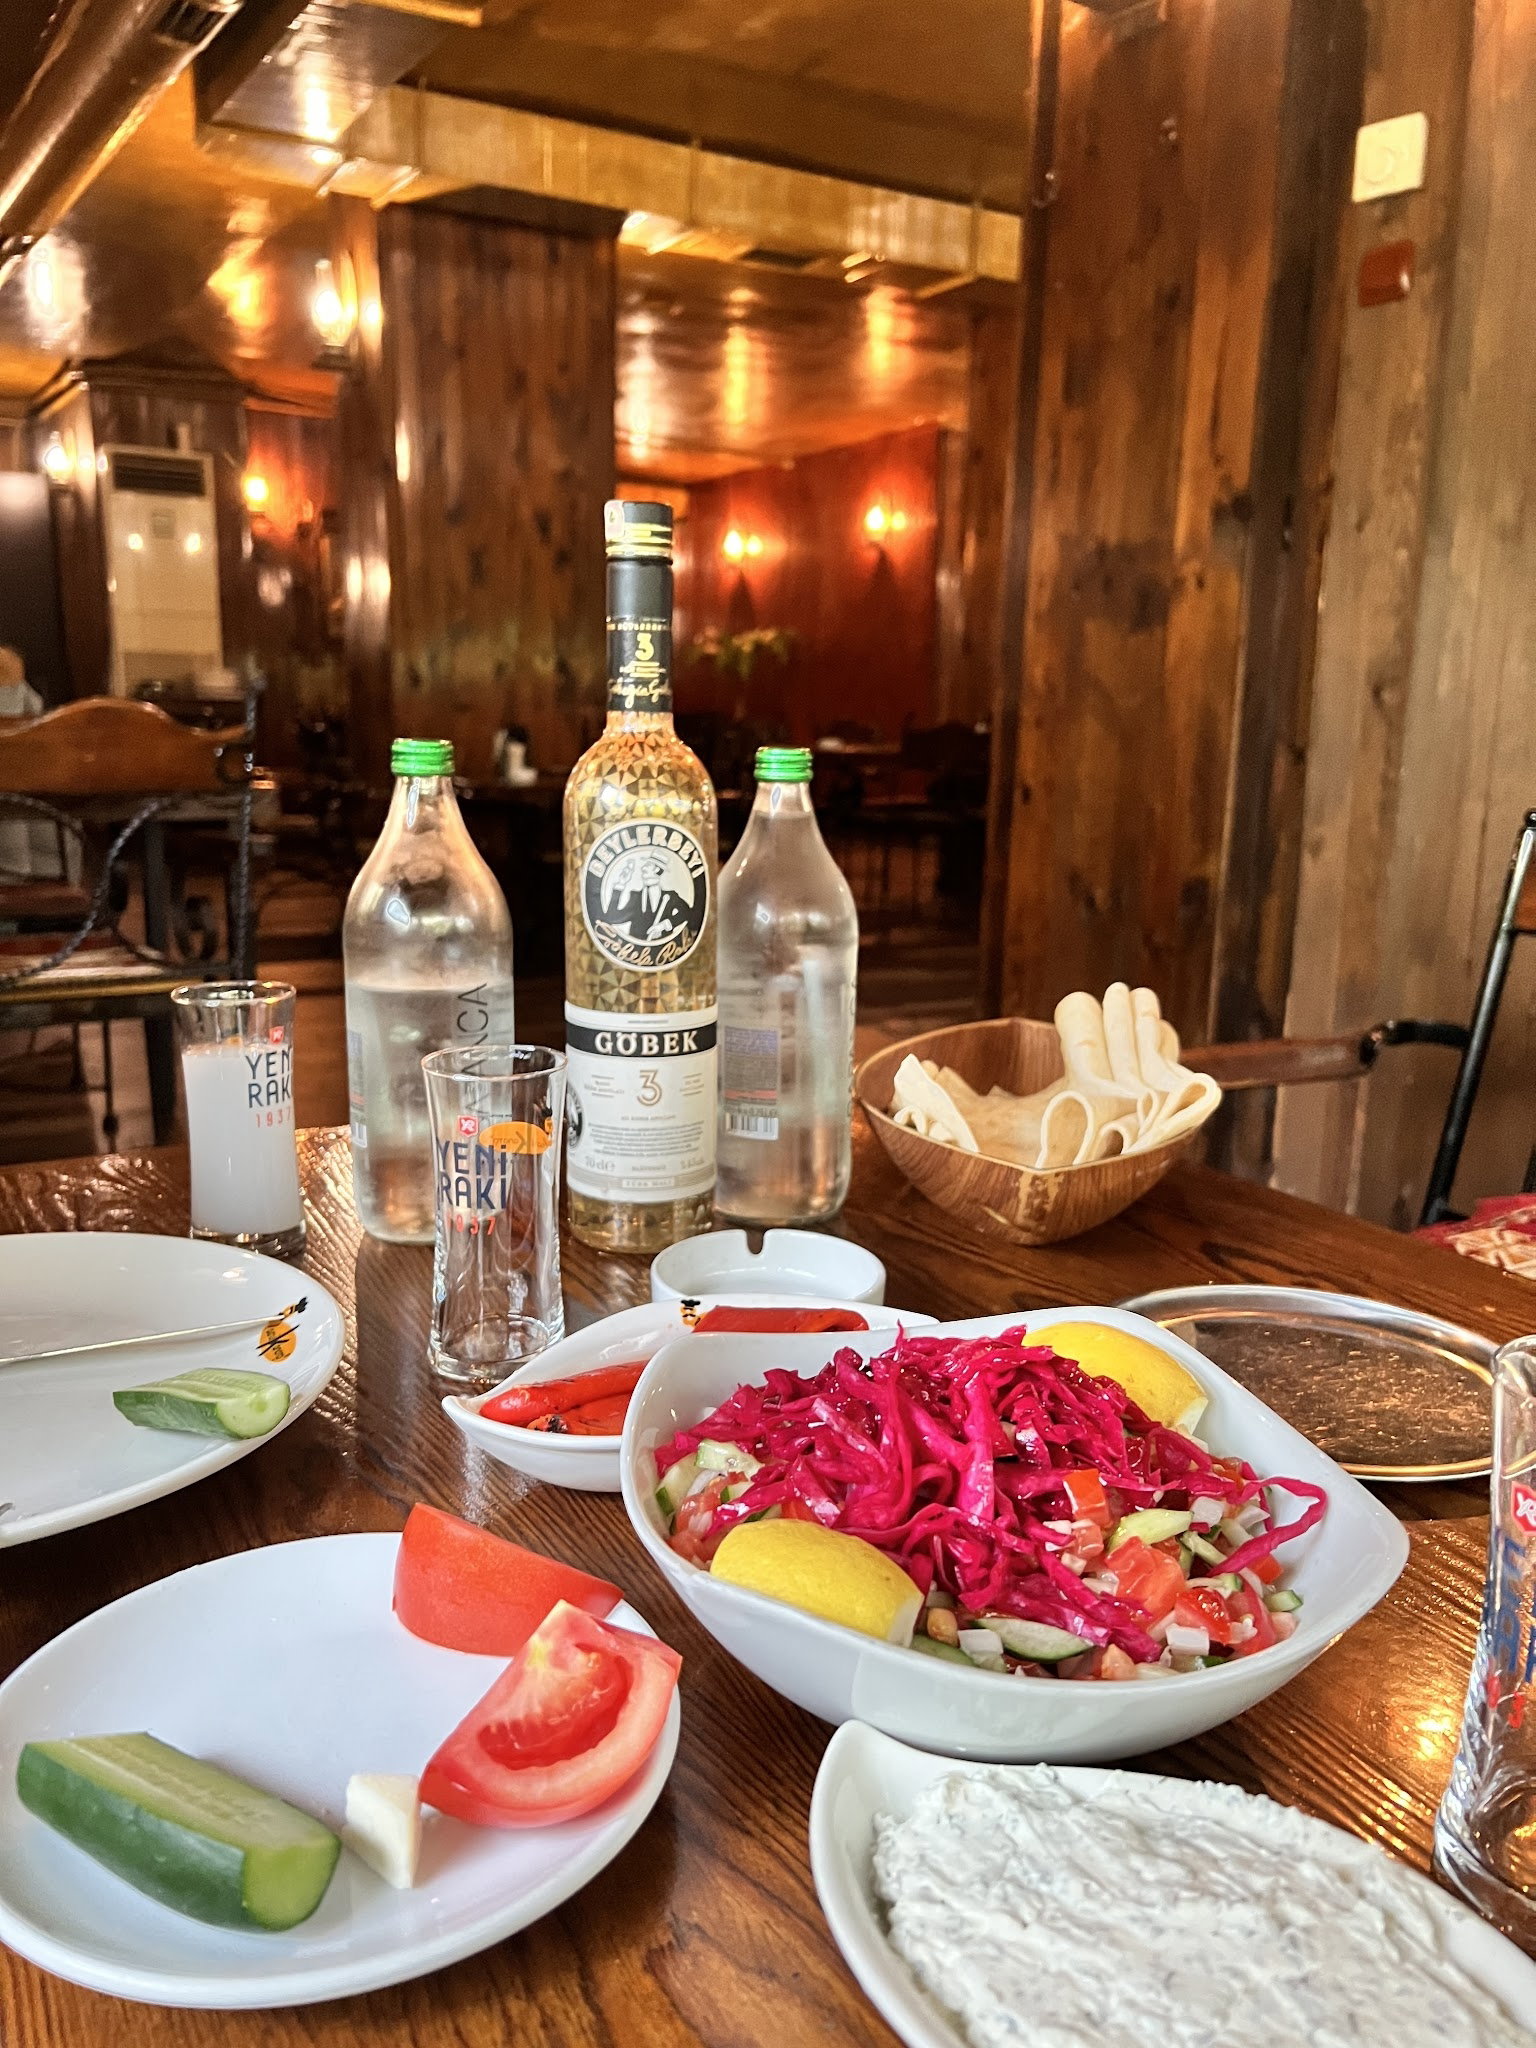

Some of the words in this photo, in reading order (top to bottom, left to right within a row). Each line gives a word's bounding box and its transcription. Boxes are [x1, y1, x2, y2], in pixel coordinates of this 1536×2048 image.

[635, 632, 655, 661] 3
[594, 1030, 698, 1056] GÖBEK
[636, 1068, 663, 1107] 3
